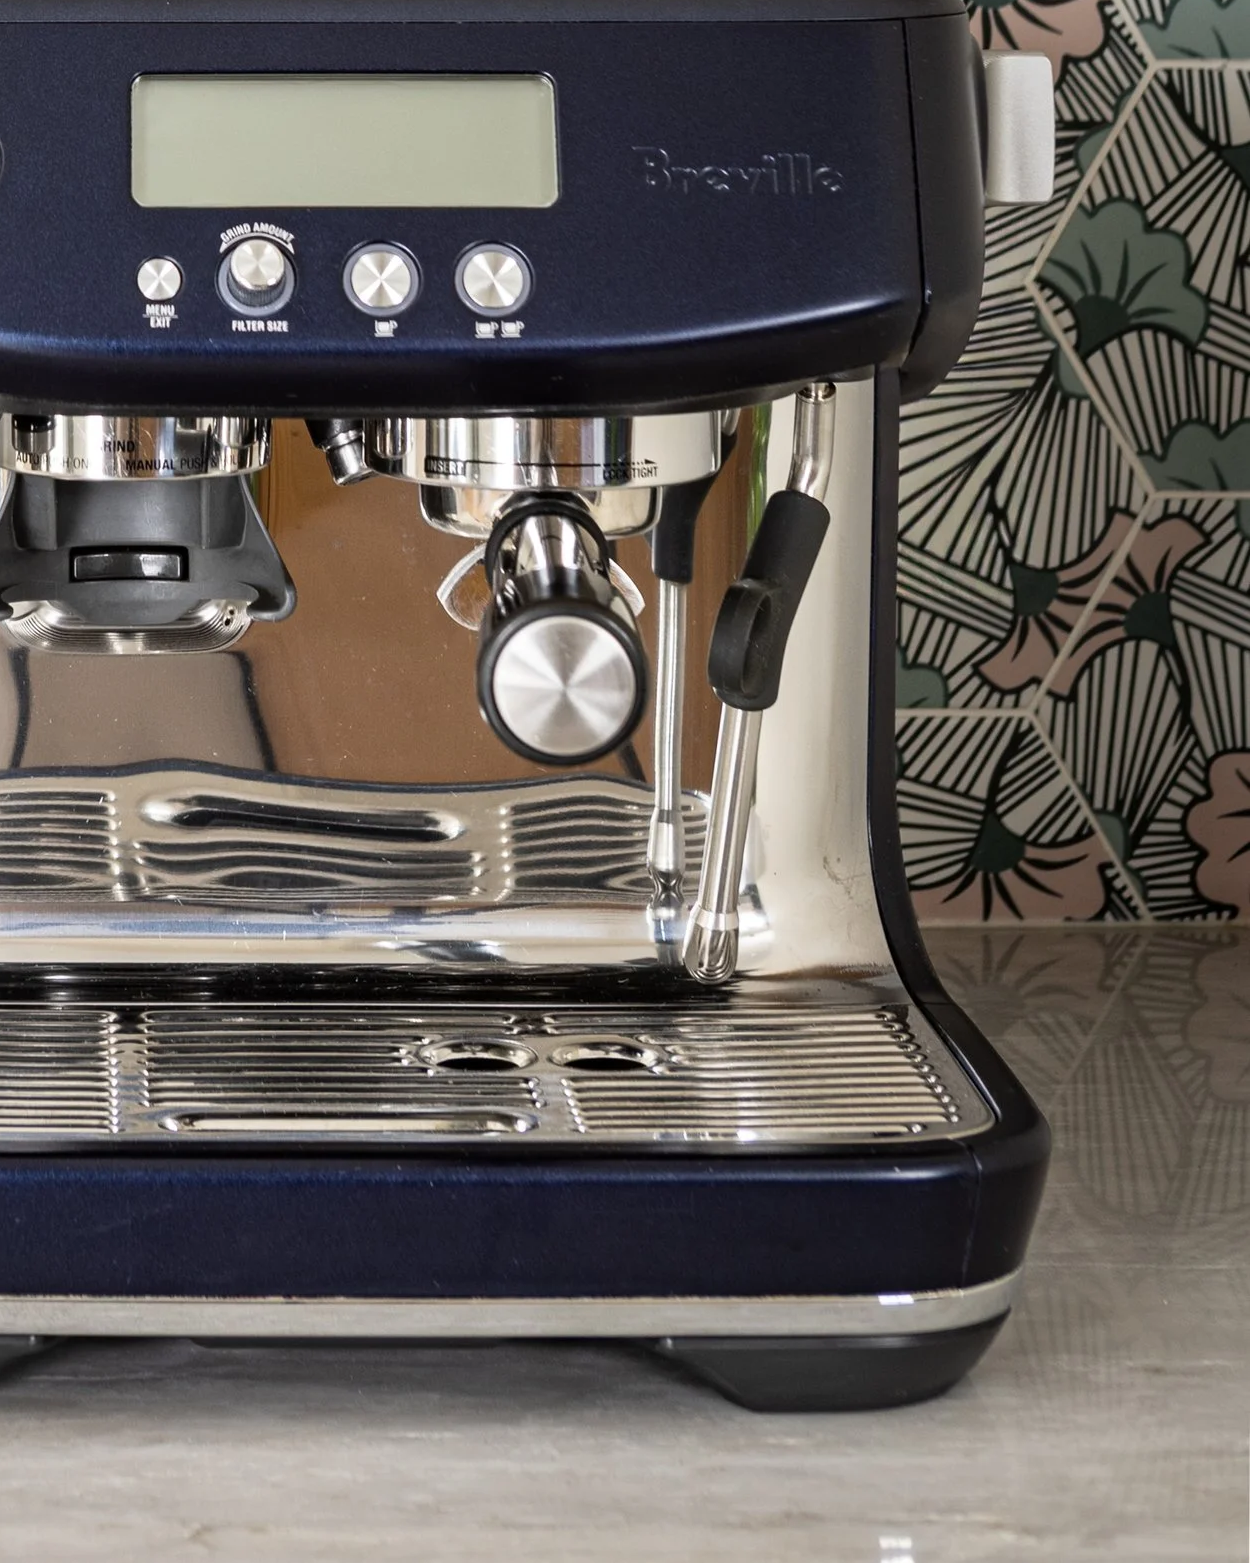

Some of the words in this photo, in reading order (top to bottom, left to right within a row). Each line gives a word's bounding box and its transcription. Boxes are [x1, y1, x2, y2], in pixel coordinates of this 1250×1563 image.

[631, 145, 845, 195] Breville
[220, 223, 252, 244] GRIND
[253, 222, 295, 244] AMOUNT
[145, 304, 175, 316] MENU
[150, 317, 172, 329] EXIT
[231, 320, 265, 332] FILTER
[266, 320, 289, 333] SIZE
[98, 440, 135, 453] RIND
[125, 458, 176, 471] MANUAL
[426, 459, 463, 475] INSERT
[631, 466, 659, 479] TIGHT
